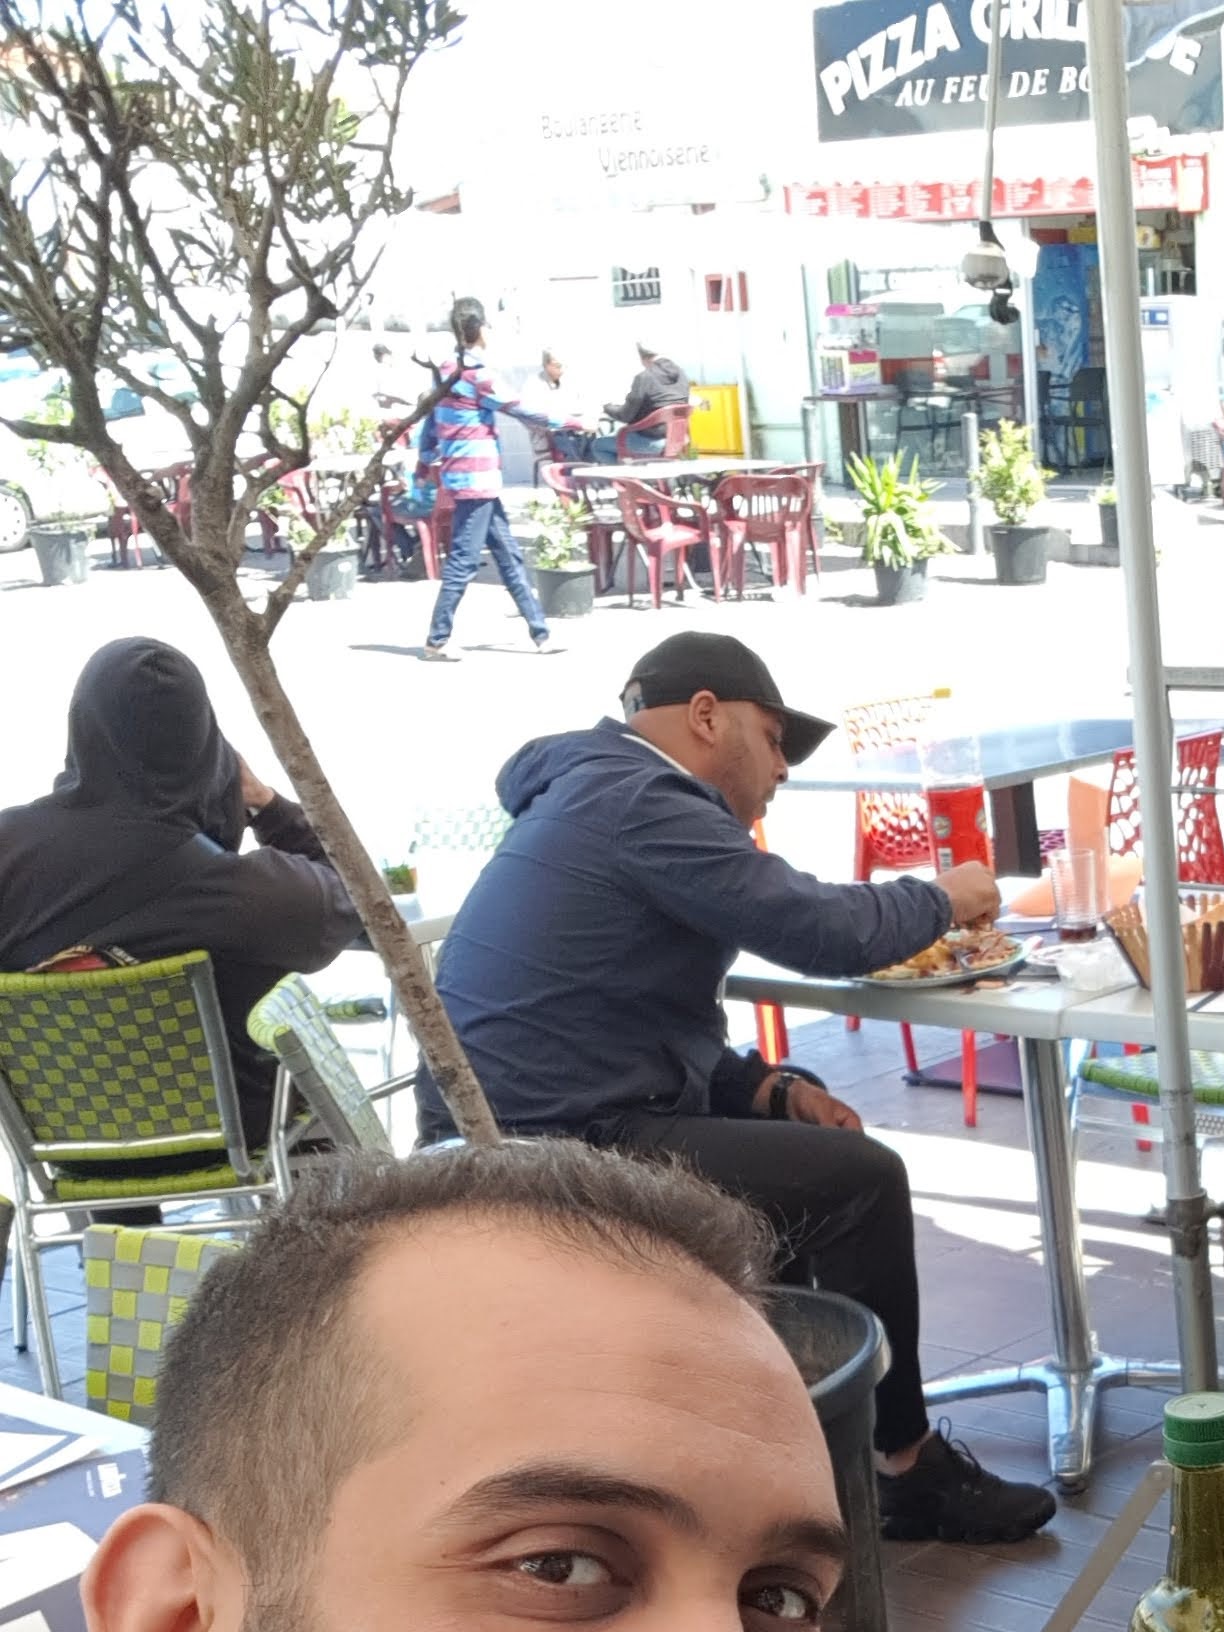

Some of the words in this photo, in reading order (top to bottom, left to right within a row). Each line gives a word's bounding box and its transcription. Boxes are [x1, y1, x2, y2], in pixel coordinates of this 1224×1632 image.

[819, 2, 960, 116] PIZZA
[895, 79, 935, 107] AU
[1008, 69, 1049, 98] DE
